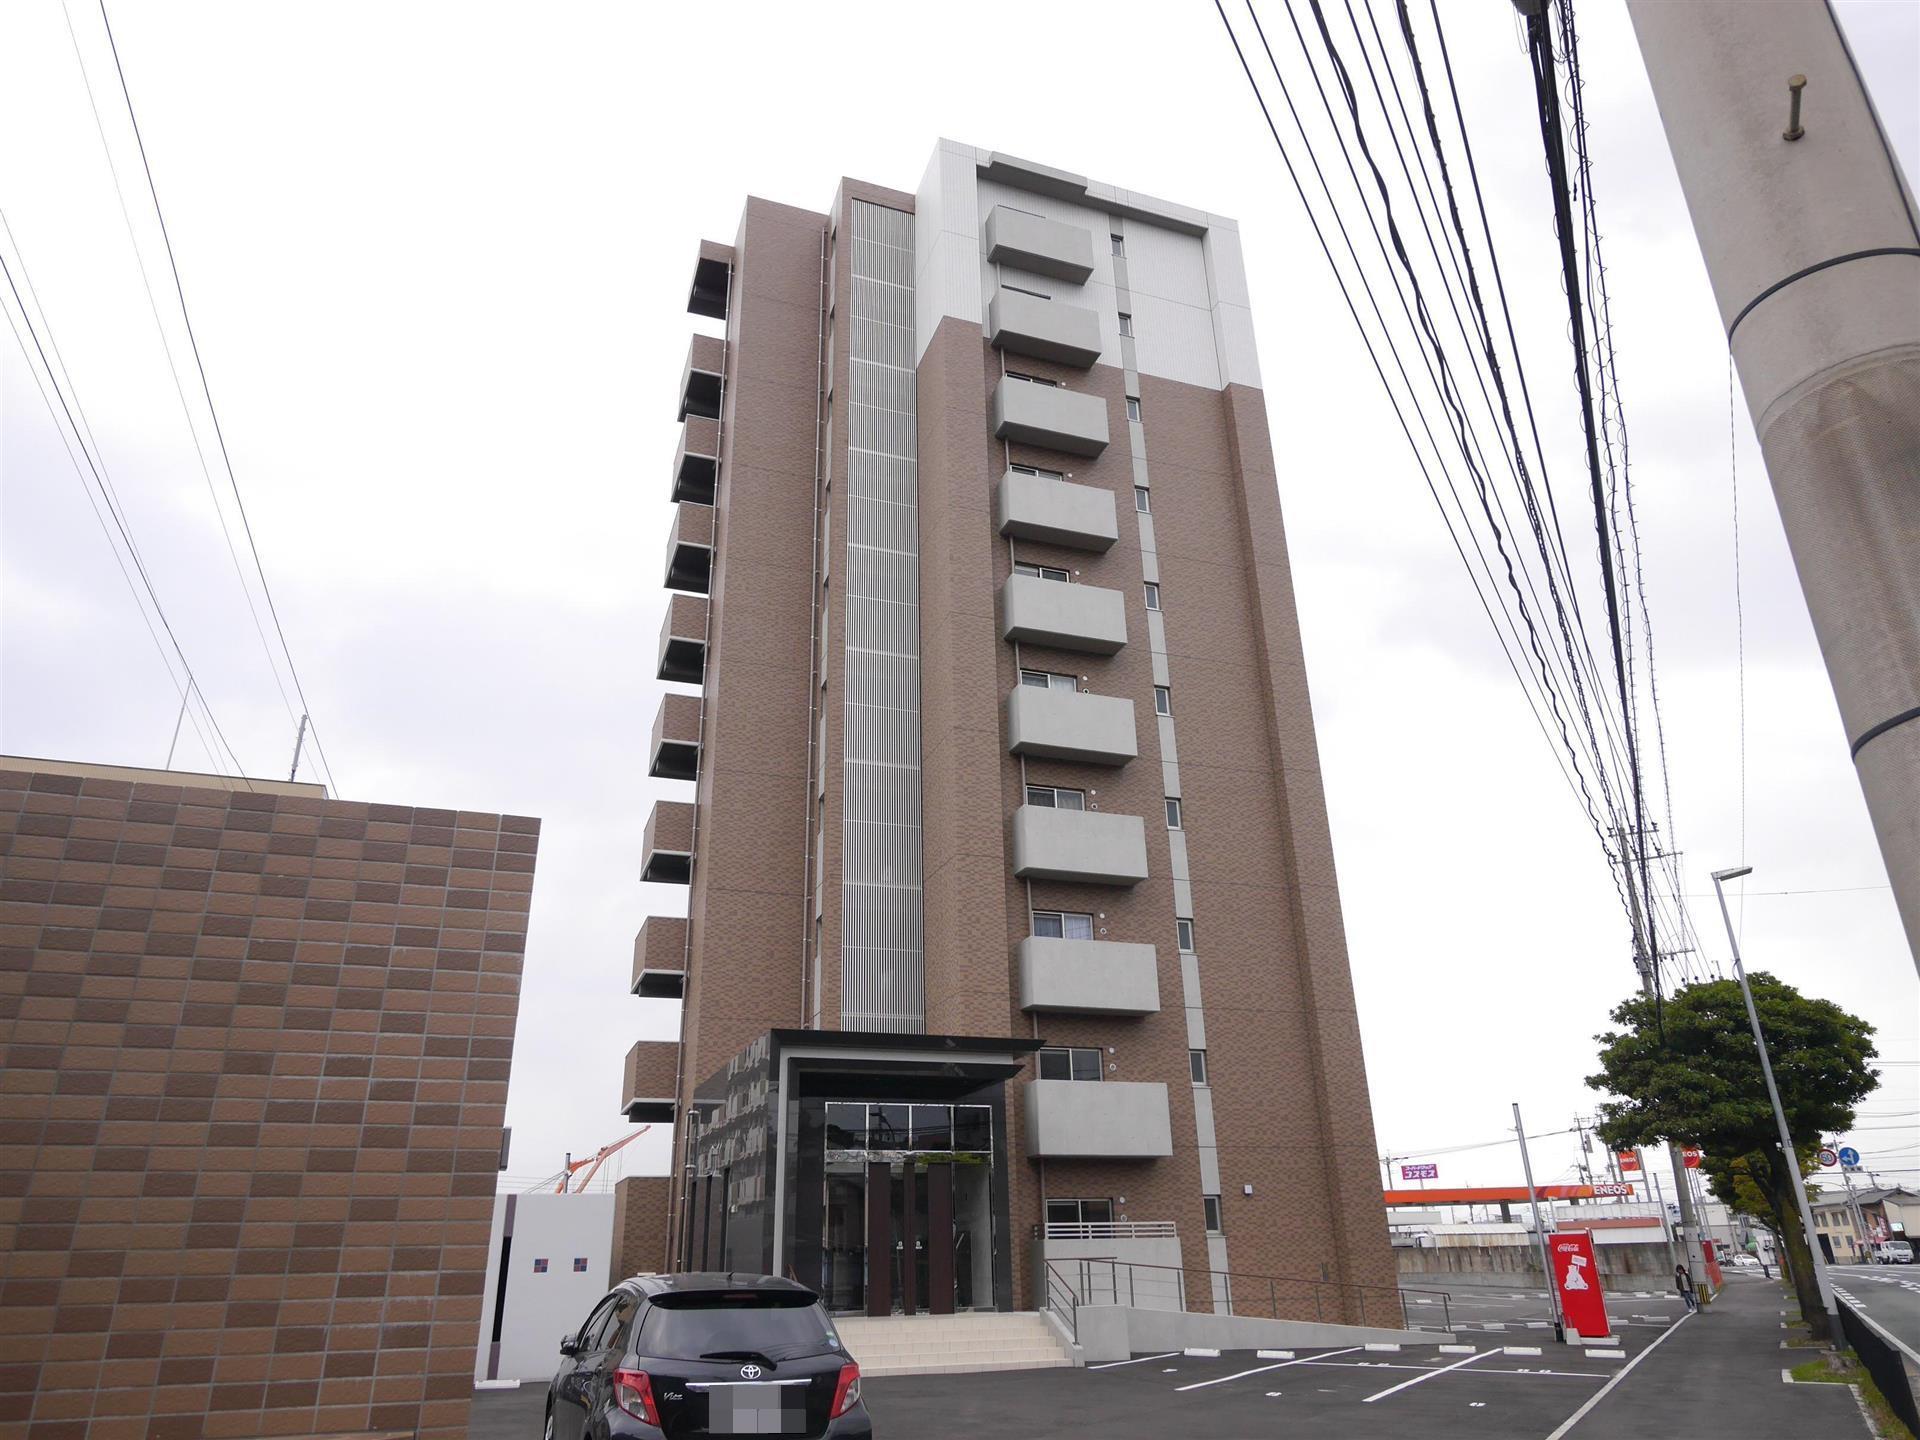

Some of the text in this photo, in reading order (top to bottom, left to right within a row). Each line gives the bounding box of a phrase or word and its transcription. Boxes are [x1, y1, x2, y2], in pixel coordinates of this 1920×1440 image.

[1404, 1169, 1436, 1179] コスモス
[1594, 1184, 1627, 1194] ENEOS
